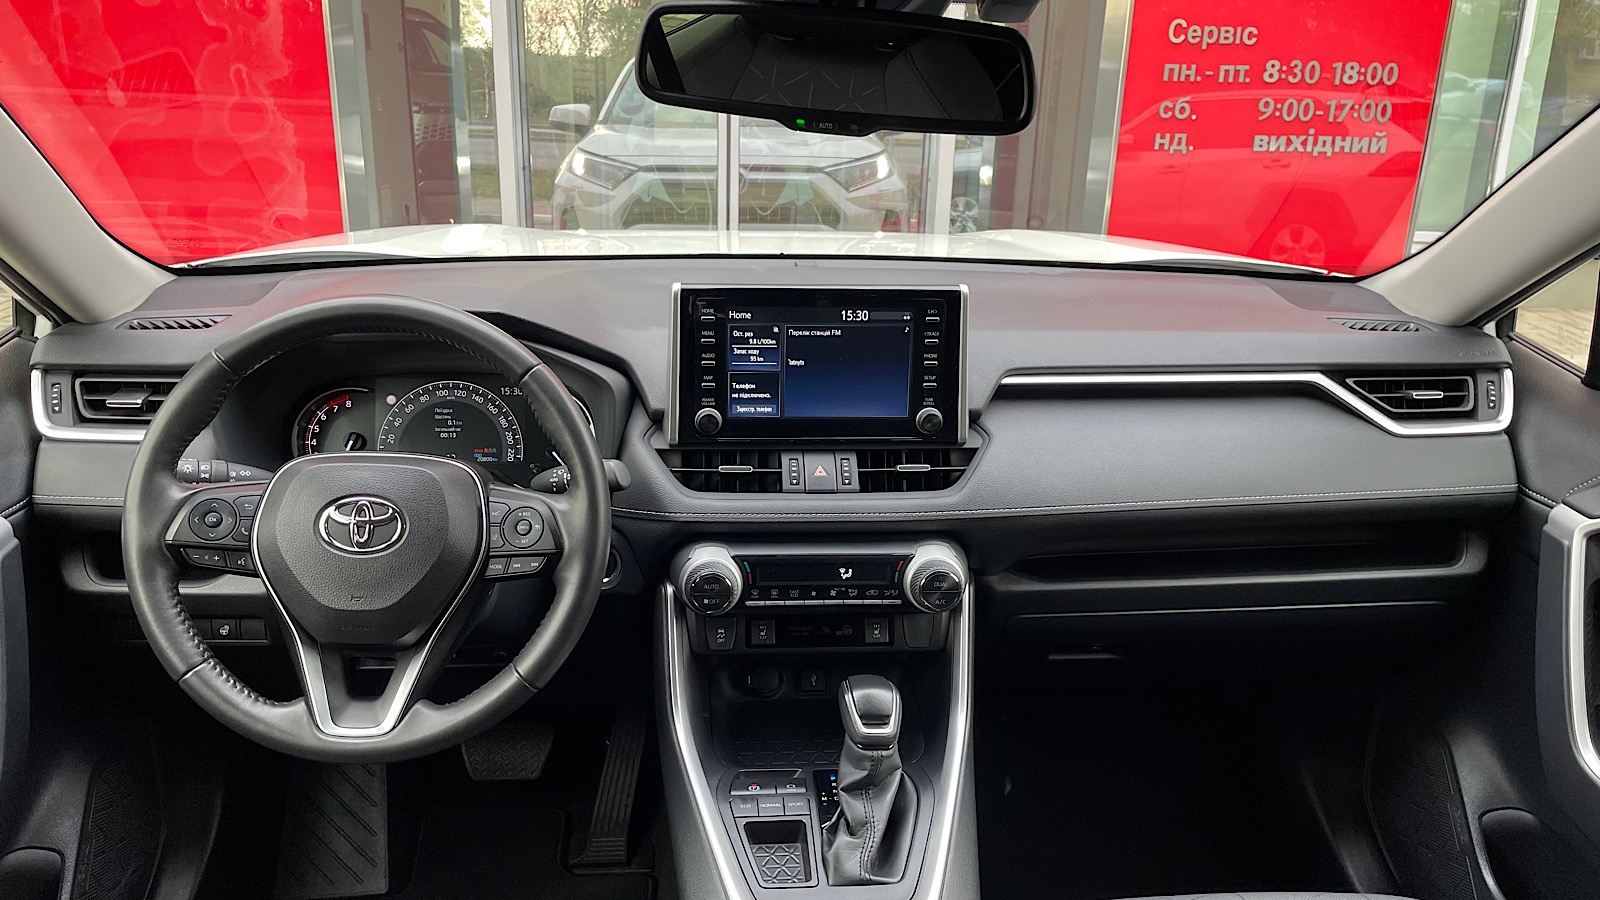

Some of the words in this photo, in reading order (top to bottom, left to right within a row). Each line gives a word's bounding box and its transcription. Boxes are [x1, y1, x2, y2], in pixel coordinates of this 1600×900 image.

[1168, 18, 1259, 50] Сервіс
[1158, 96, 1198, 120] сб.
[1257, 97, 1393, 123] 9:00-17:00
[819, 122, 834, 130] AUTO
[1153, 132, 1195, 154] нд.
[1252, 128, 1389, 157] вихідний
[729, 310, 752, 320] Home
[841, 310, 869, 322] 15:30
[788, 329, 810, 337] Перелік
[811, 329, 831, 337] станцій
[731, 382, 756, 390] Телефон
[435, 389, 449, 397] 100
[453, 389, 467, 398] 120
[419, 394, 430, 403] 80
[471, 393, 484, 404] 140
[345, 400, 352, 408] 8
[404, 404, 415, 414] 60
[486, 402, 499, 415] 160
[320, 413, 327, 421] 6
[393, 417, 403, 427] 40
[498, 415, 509, 429] 180
[314, 425, 320, 433] 5
[310, 438, 317, 446] 4
[387, 434, 396, 444] 20
[505, 431, 514, 445] 200
[507, 448, 515, 462] 220
